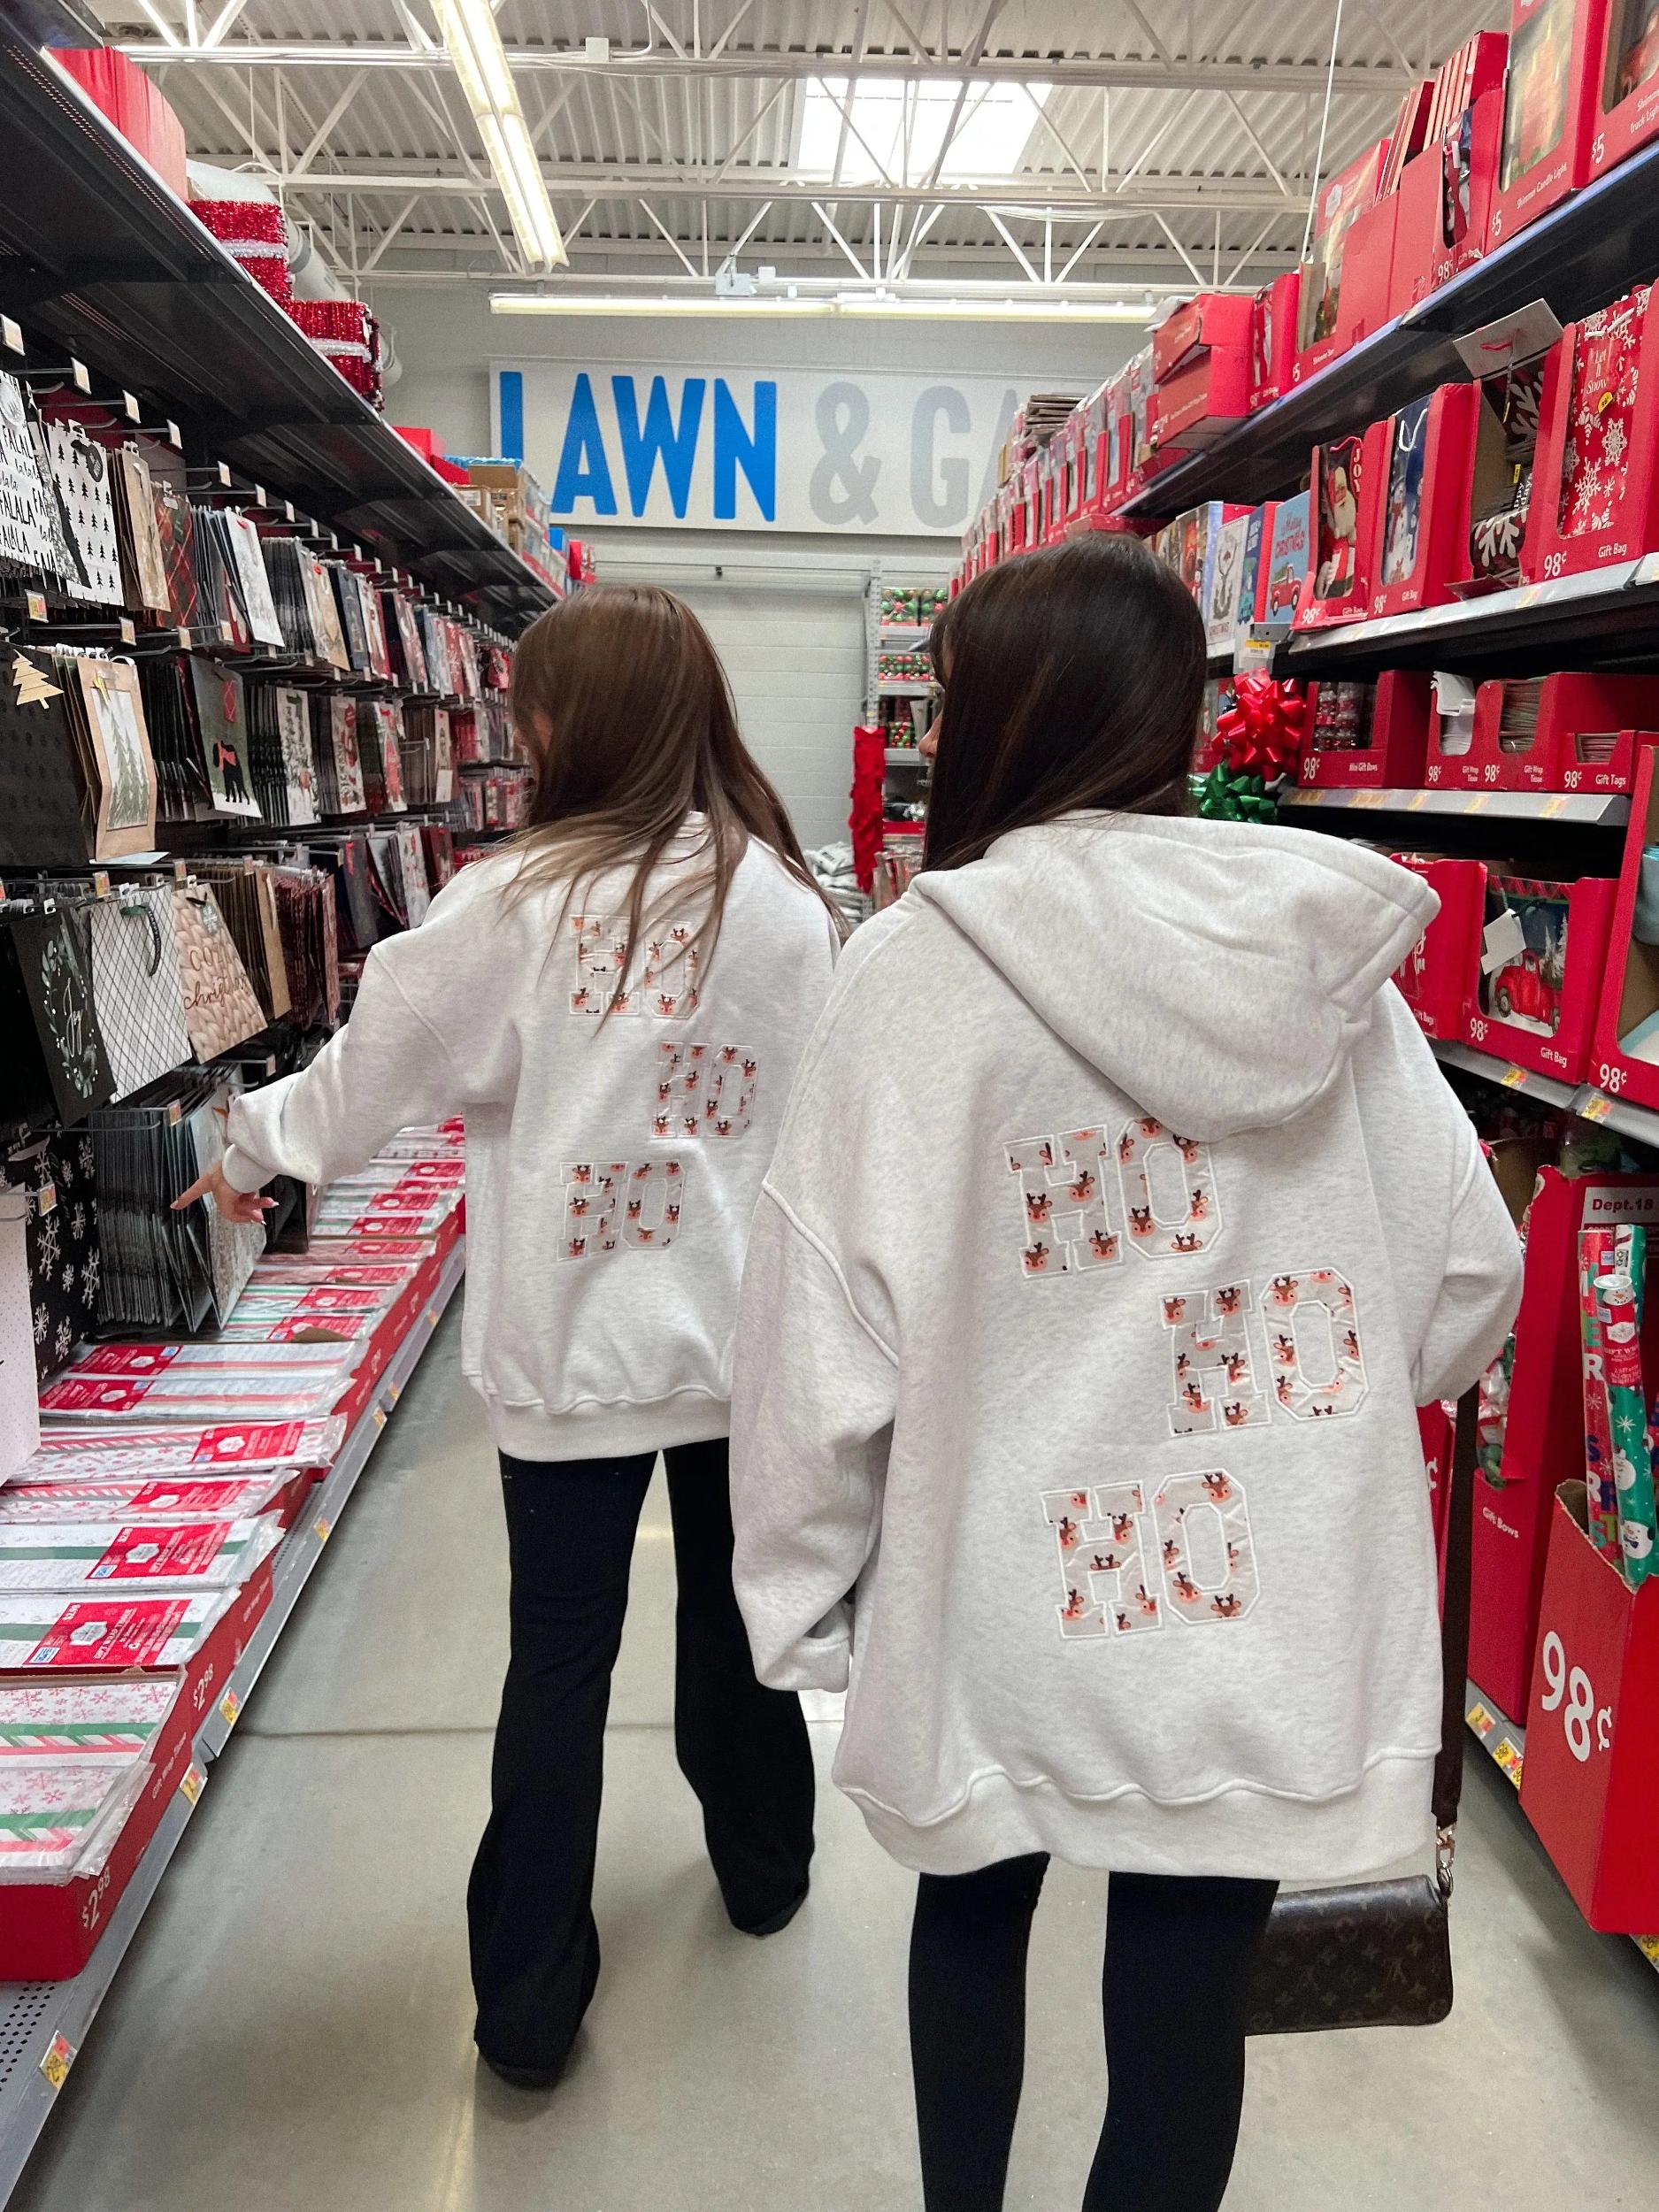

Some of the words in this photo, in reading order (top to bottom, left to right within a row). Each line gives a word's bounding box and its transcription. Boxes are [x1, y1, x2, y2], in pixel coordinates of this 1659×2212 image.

[1592, 133, 1605, 164] $5
[809, 382, 881, 524] &
[1598, 544, 1612, 559] Gift
[1613, 542, 1627, 557] Bag
[1544, 550, 1567, 580] 98¢
[1374, 594, 1387, 614] 98¢
[1302, 607, 1320, 626] 98¢
[1303, 757, 1321, 780] 98¢
[1428, 765, 1443, 782] 98¢
[1485, 764, 1501, 782] 98¢
[1564, 771, 1583, 789] 98¢
[1595, 774, 1609, 786] Gift
[1610, 774, 1626, 788] Tags
[1470, 1018, 1488, 1041] 98¢
[1540, 1048, 1554, 1061] Gift
[1554, 1051, 1567, 1069] Bag
[1600, 1064, 1628, 1093] 98¢
[1003, 1117, 1225, 1279] HO
[557, 1160, 687, 1261] HO
[1160, 1266, 1371, 1438] HO
[1040, 1467, 1261, 1639] HO
[1542, 1631, 1612, 1762] 98¢
